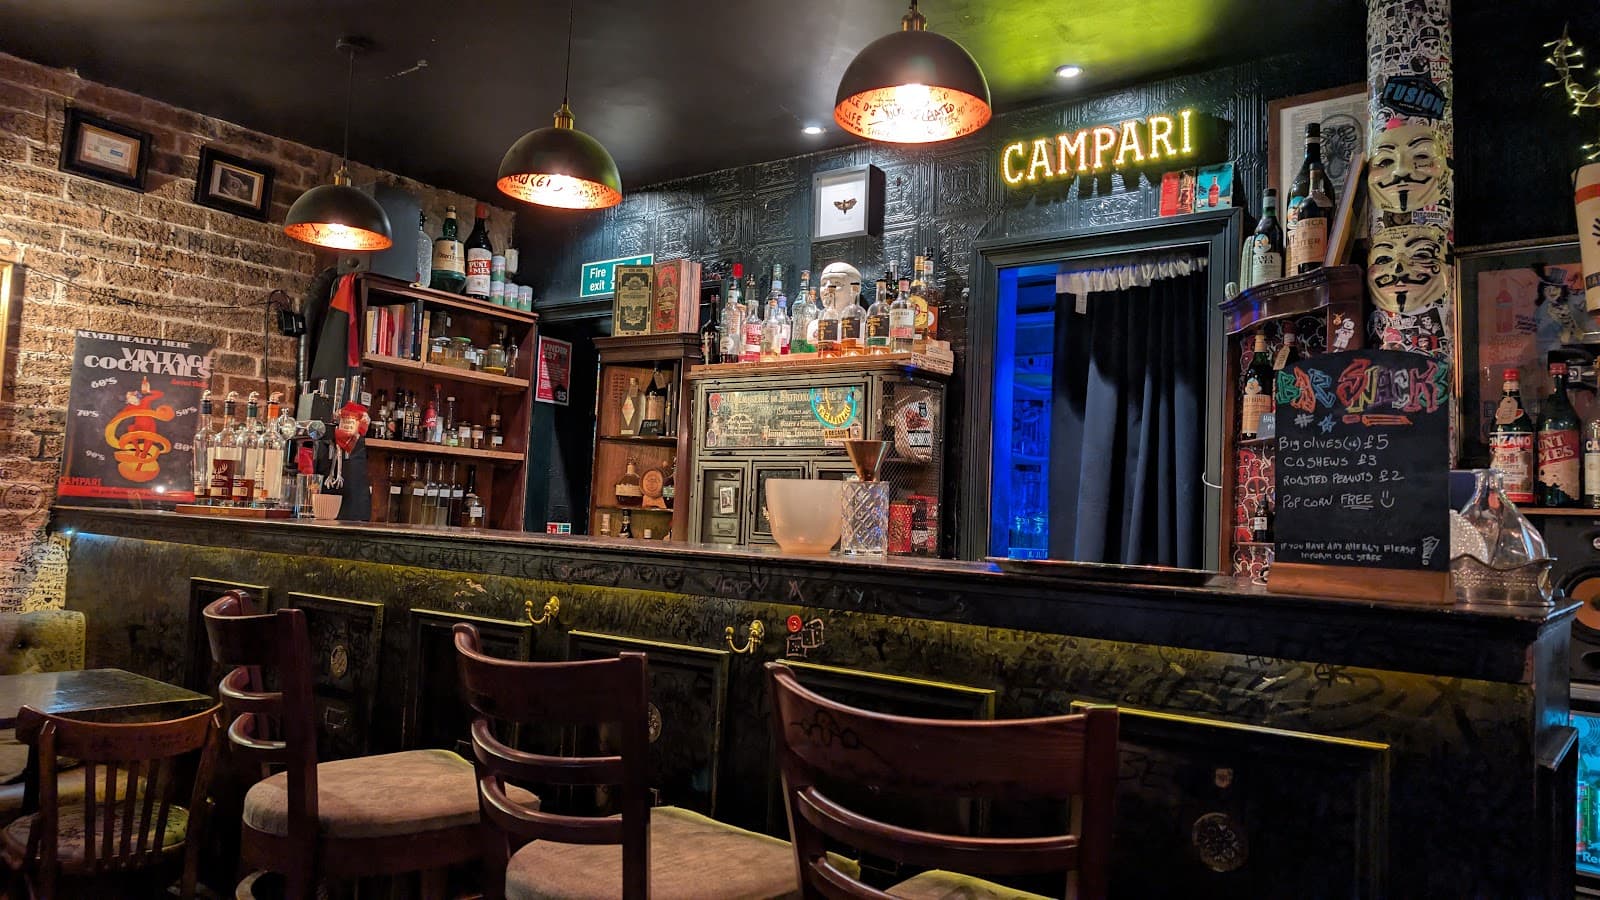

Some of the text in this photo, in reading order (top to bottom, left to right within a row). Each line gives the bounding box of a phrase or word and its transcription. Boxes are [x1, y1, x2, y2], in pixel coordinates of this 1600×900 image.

[1430, 61, 1449, 71] RUN
[1383, 82, 1446, 115] FUSION
[1003, 110, 1193, 185] CAMPARI
[468, 260, 489, 268] PUNT
[589, 267, 607, 279] Fire
[589, 280, 605, 292] exit
[78, 330, 192, 349] NEVER REALLY HERE
[83, 354, 212, 379] COCKTAILS
[121, 347, 216, 370] VINTAGE
[1276, 358, 1449, 414] BAR SNACKS
[1363, 433, 1390, 450] £5
[1537, 435, 1564, 450] UNT
[1283, 453, 1378, 469] CASHEWS £3
[59, 476, 103, 487] CAMPARI
[1283, 469, 1406, 487] ROASTED PEANUTS £2
[1340, 493, 1375, 505] FREE
